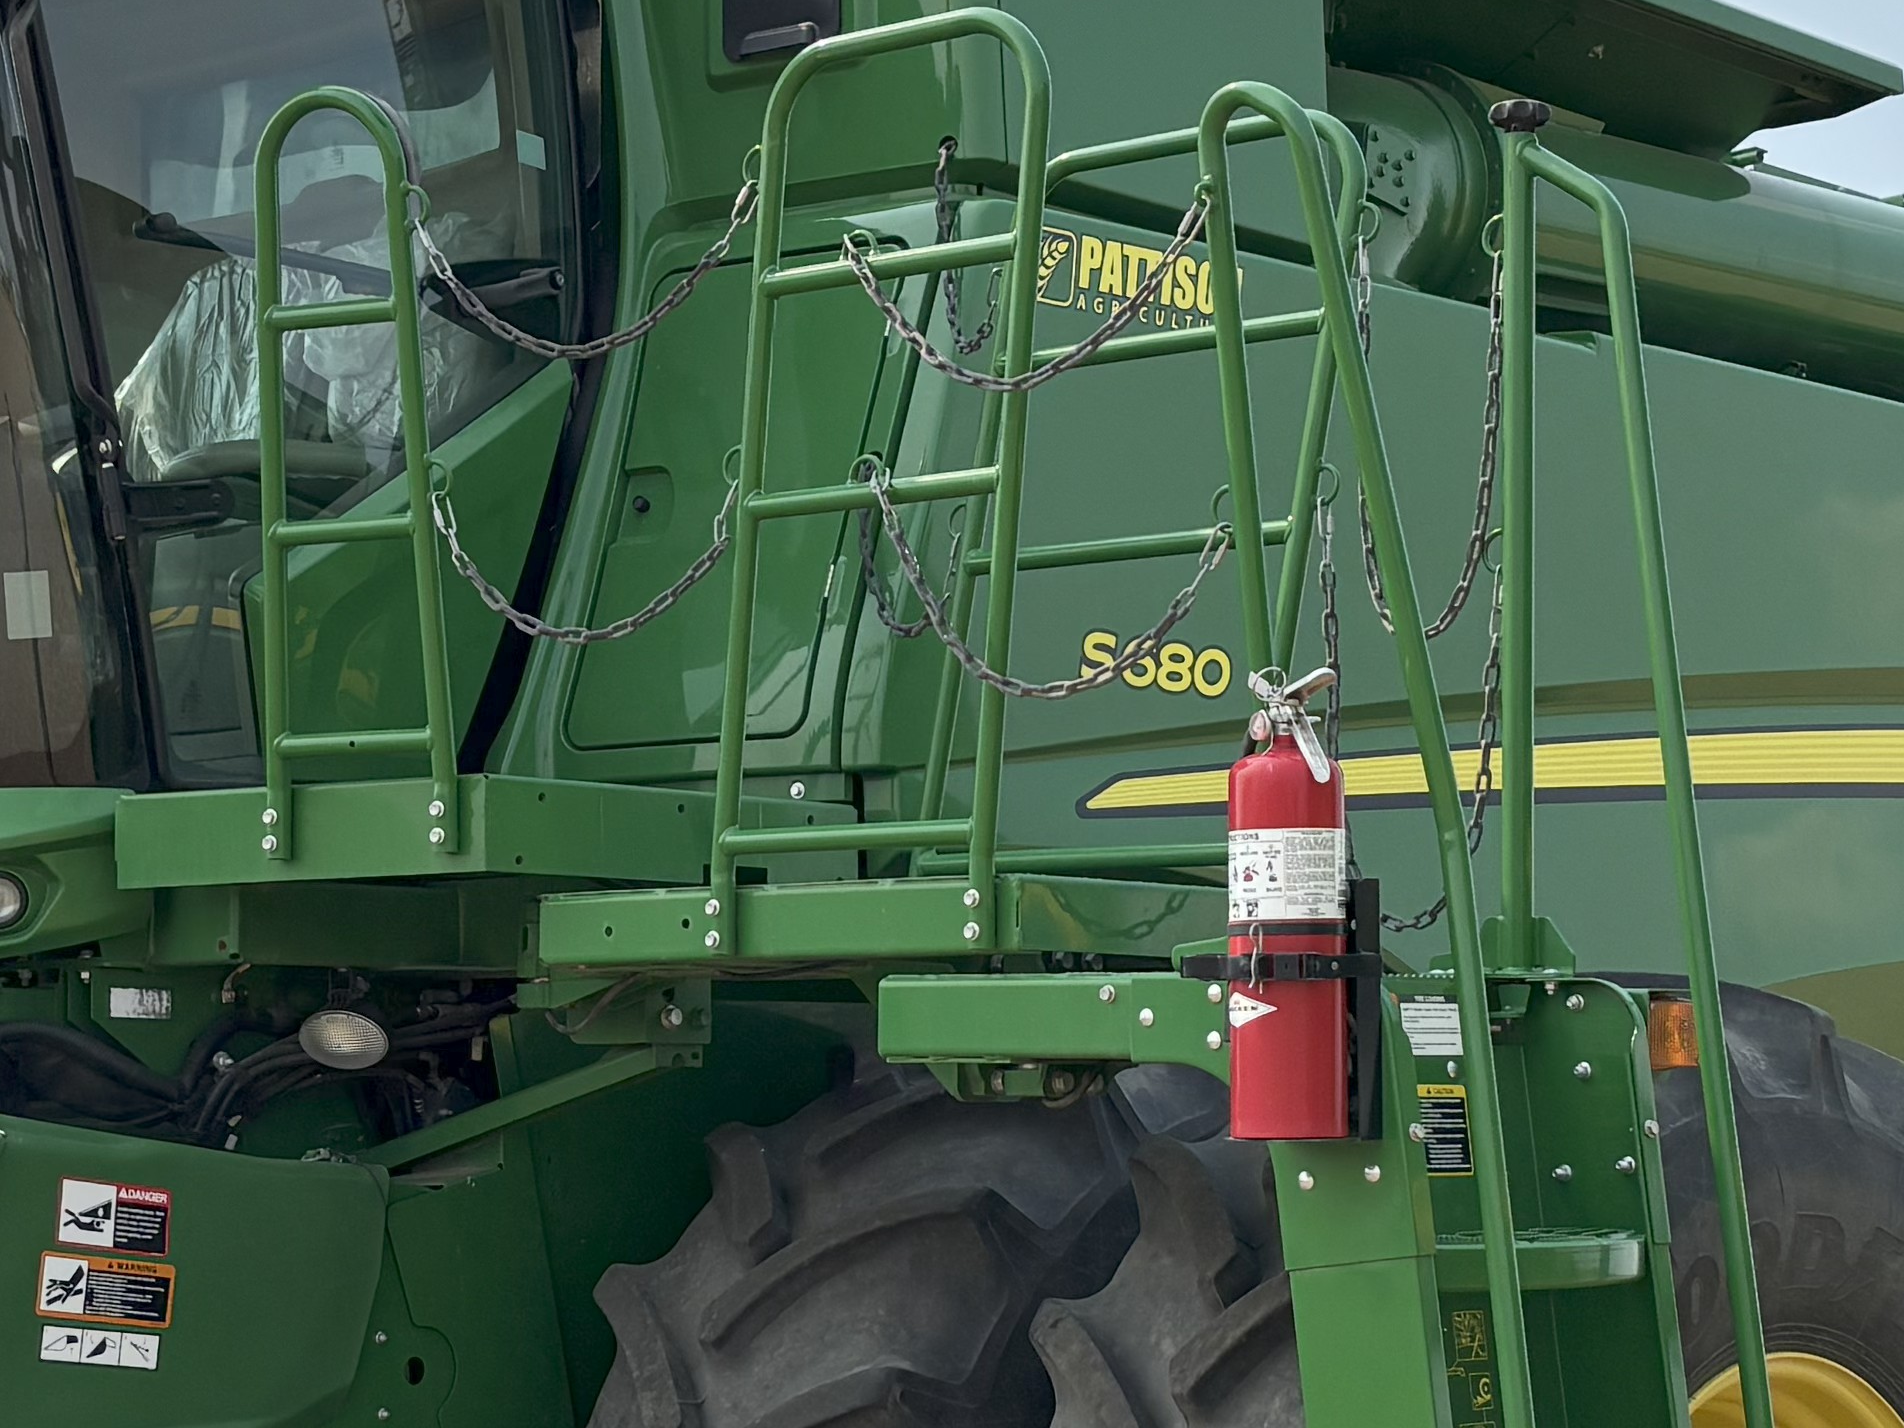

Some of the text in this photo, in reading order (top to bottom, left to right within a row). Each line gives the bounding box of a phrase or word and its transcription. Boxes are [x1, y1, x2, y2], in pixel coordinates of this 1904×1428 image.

[1079, 235, 1243, 316] PATTISO
[1079, 629, 1232, 698] S680
[127, 1189, 168, 1204] DANGER
[116, 1260, 158, 1275] WARNING
